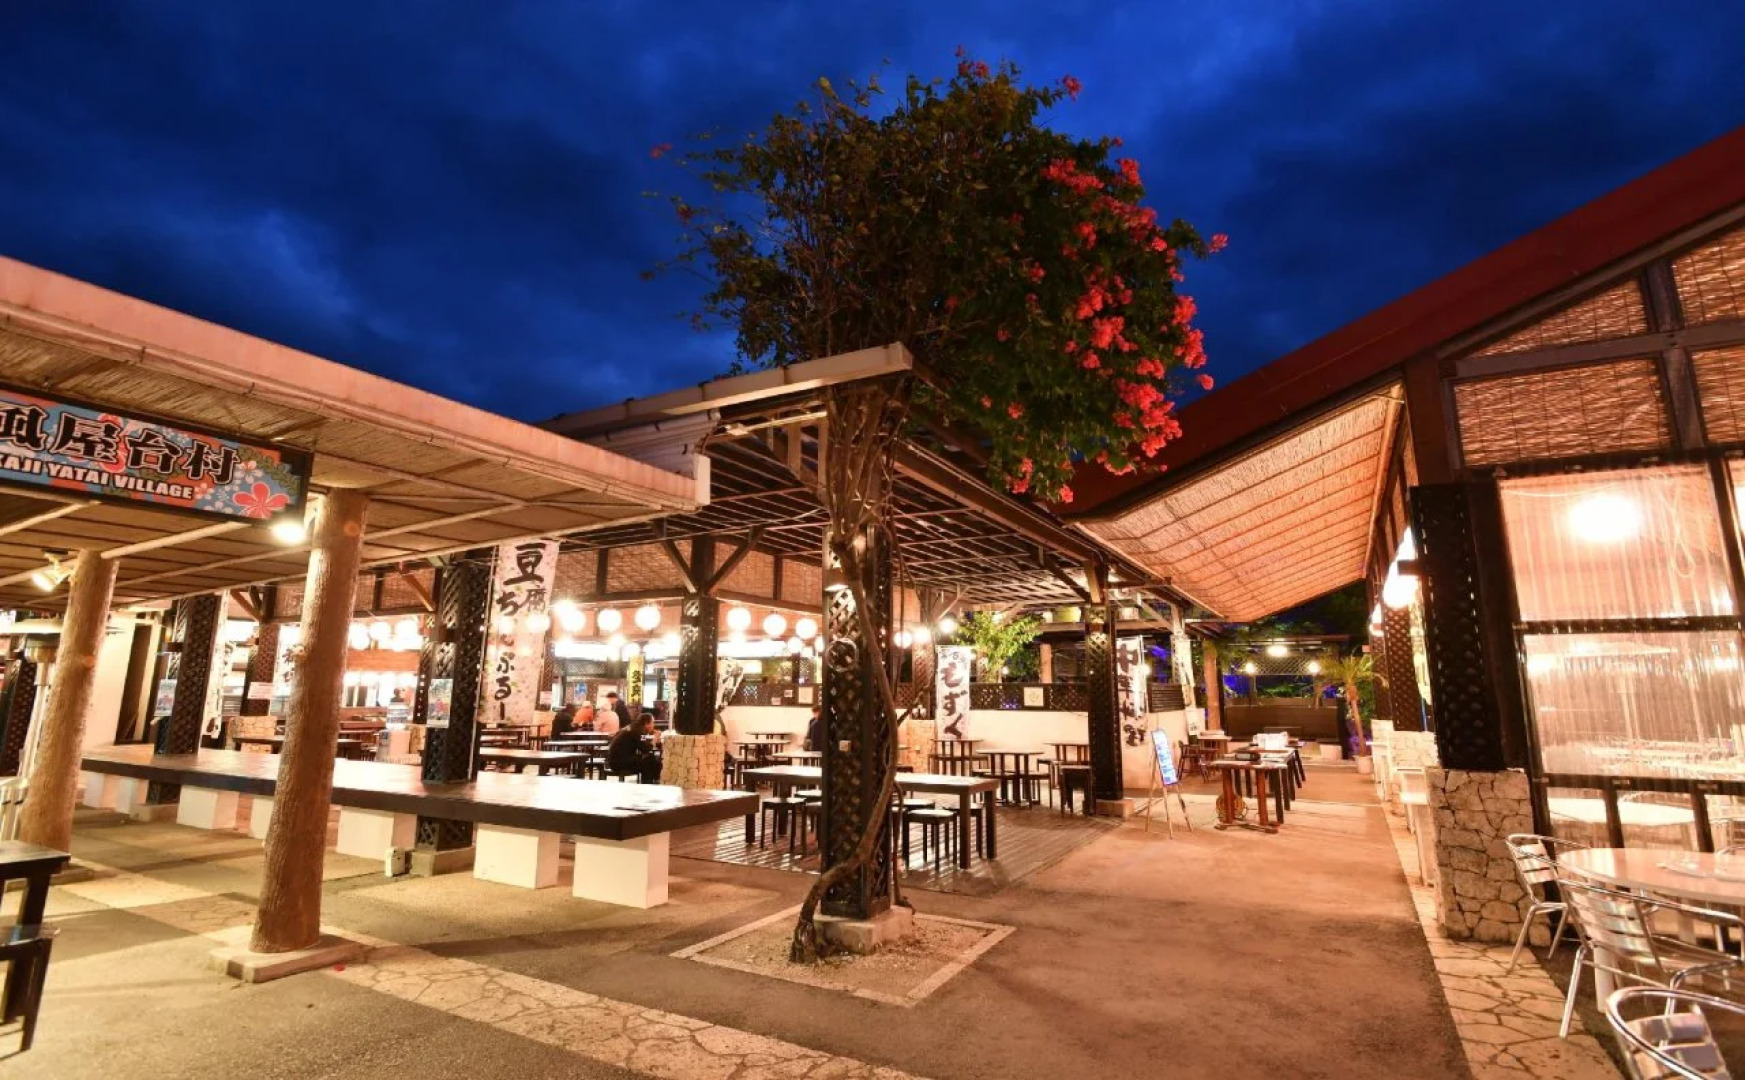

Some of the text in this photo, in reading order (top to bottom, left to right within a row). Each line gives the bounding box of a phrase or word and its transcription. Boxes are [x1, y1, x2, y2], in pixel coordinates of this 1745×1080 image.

[0, 453, 193, 500] AJI YATAI VILLAGE
[495, 543, 547, 720] 豆腐ちぷるー
[941, 662, 968, 740] もずく
